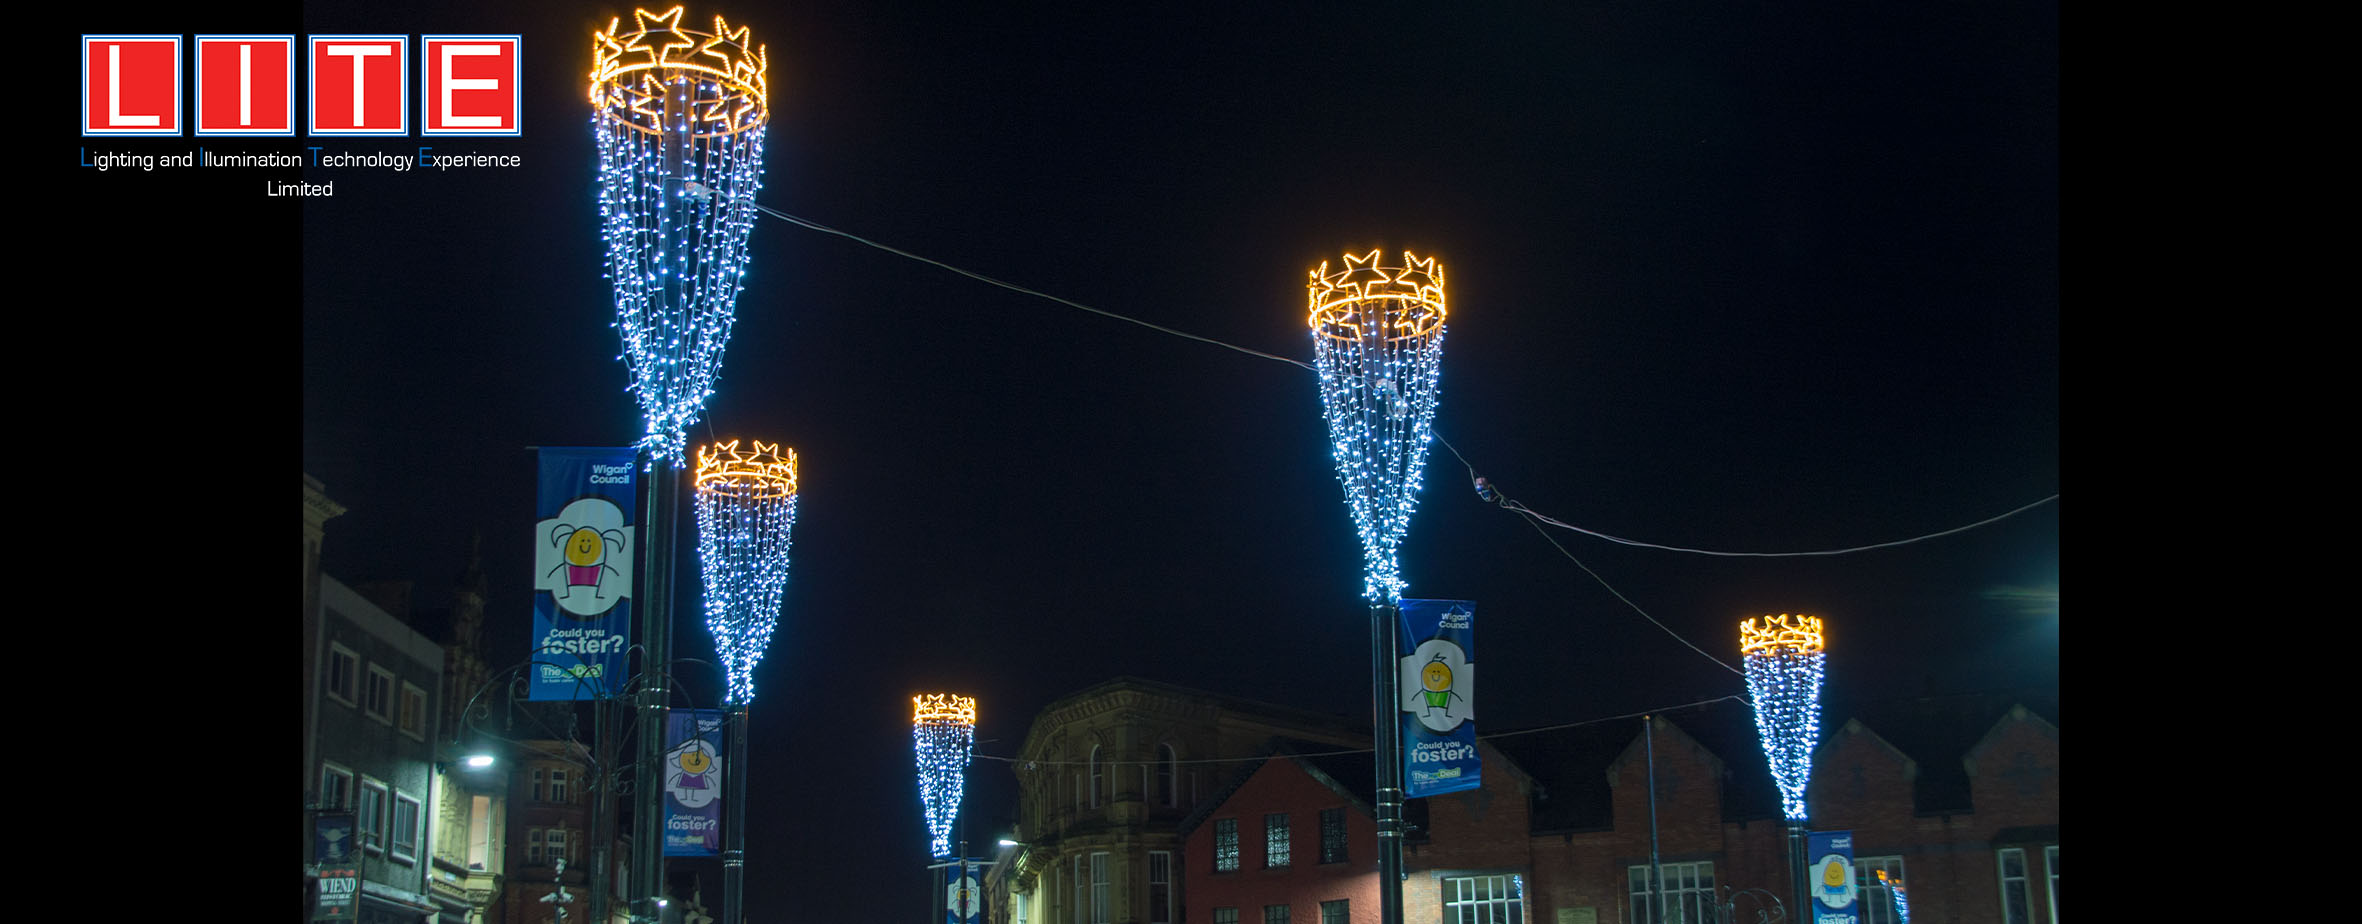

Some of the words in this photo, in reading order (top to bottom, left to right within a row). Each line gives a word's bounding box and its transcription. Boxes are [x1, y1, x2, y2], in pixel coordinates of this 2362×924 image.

[592, 464, 627, 476] Wigan
[590, 474, 630, 484] Council
[1441, 612, 1467, 622] Wigan
[1438, 620, 1469, 629] Council
[550, 628, 582, 638] Could
[584, 629, 605, 639] you
[542, 635, 624, 654] foster?
[1444, 741, 1460, 750] you
[1411, 744, 1474, 763] foster?
[668, 818, 716, 830] foster?
[320, 878, 357, 893] WIEND
